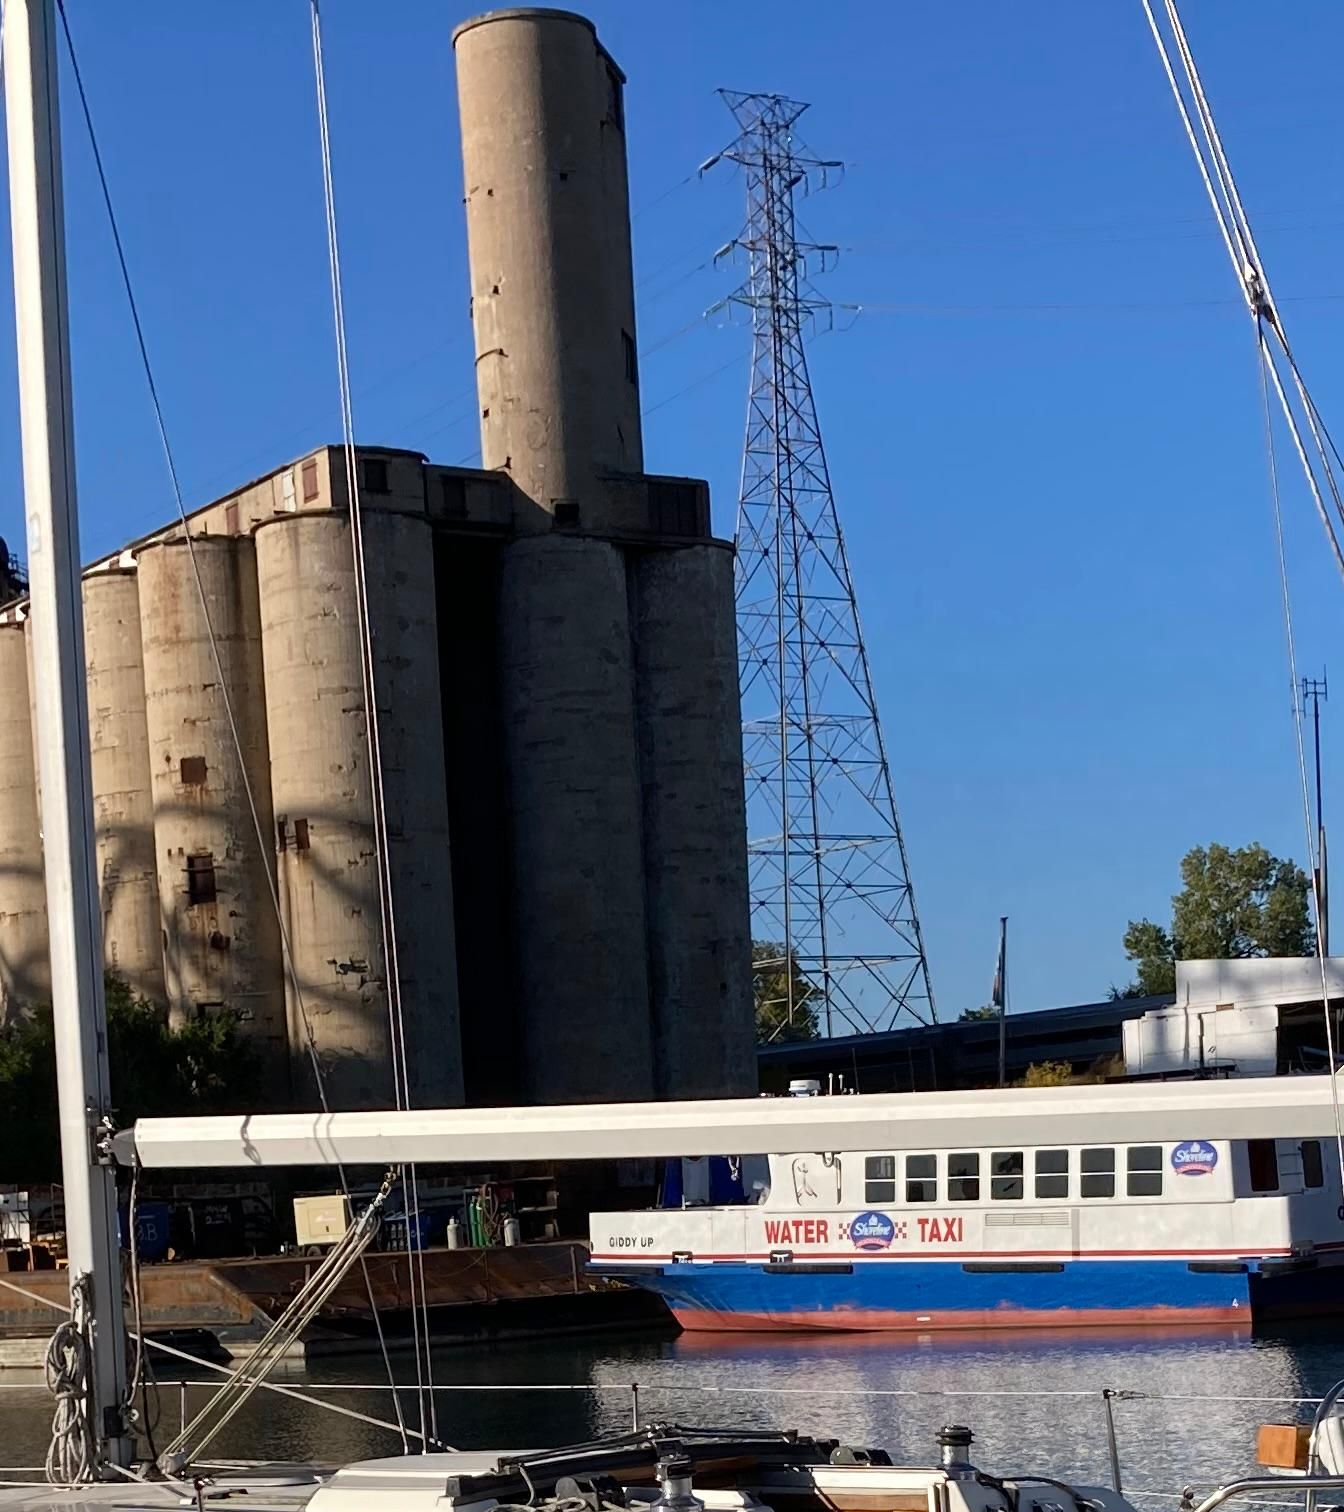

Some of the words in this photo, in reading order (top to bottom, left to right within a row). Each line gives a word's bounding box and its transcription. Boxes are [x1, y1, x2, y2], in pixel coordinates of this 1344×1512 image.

[764, 1219, 829, 1244] WATER
[917, 1217, 963, 1243] TAXI
[609, 1237, 637, 1248] GIDDY
[640, 1236, 654, 1247] UP
[1231, 1298, 1239, 1309] 4
